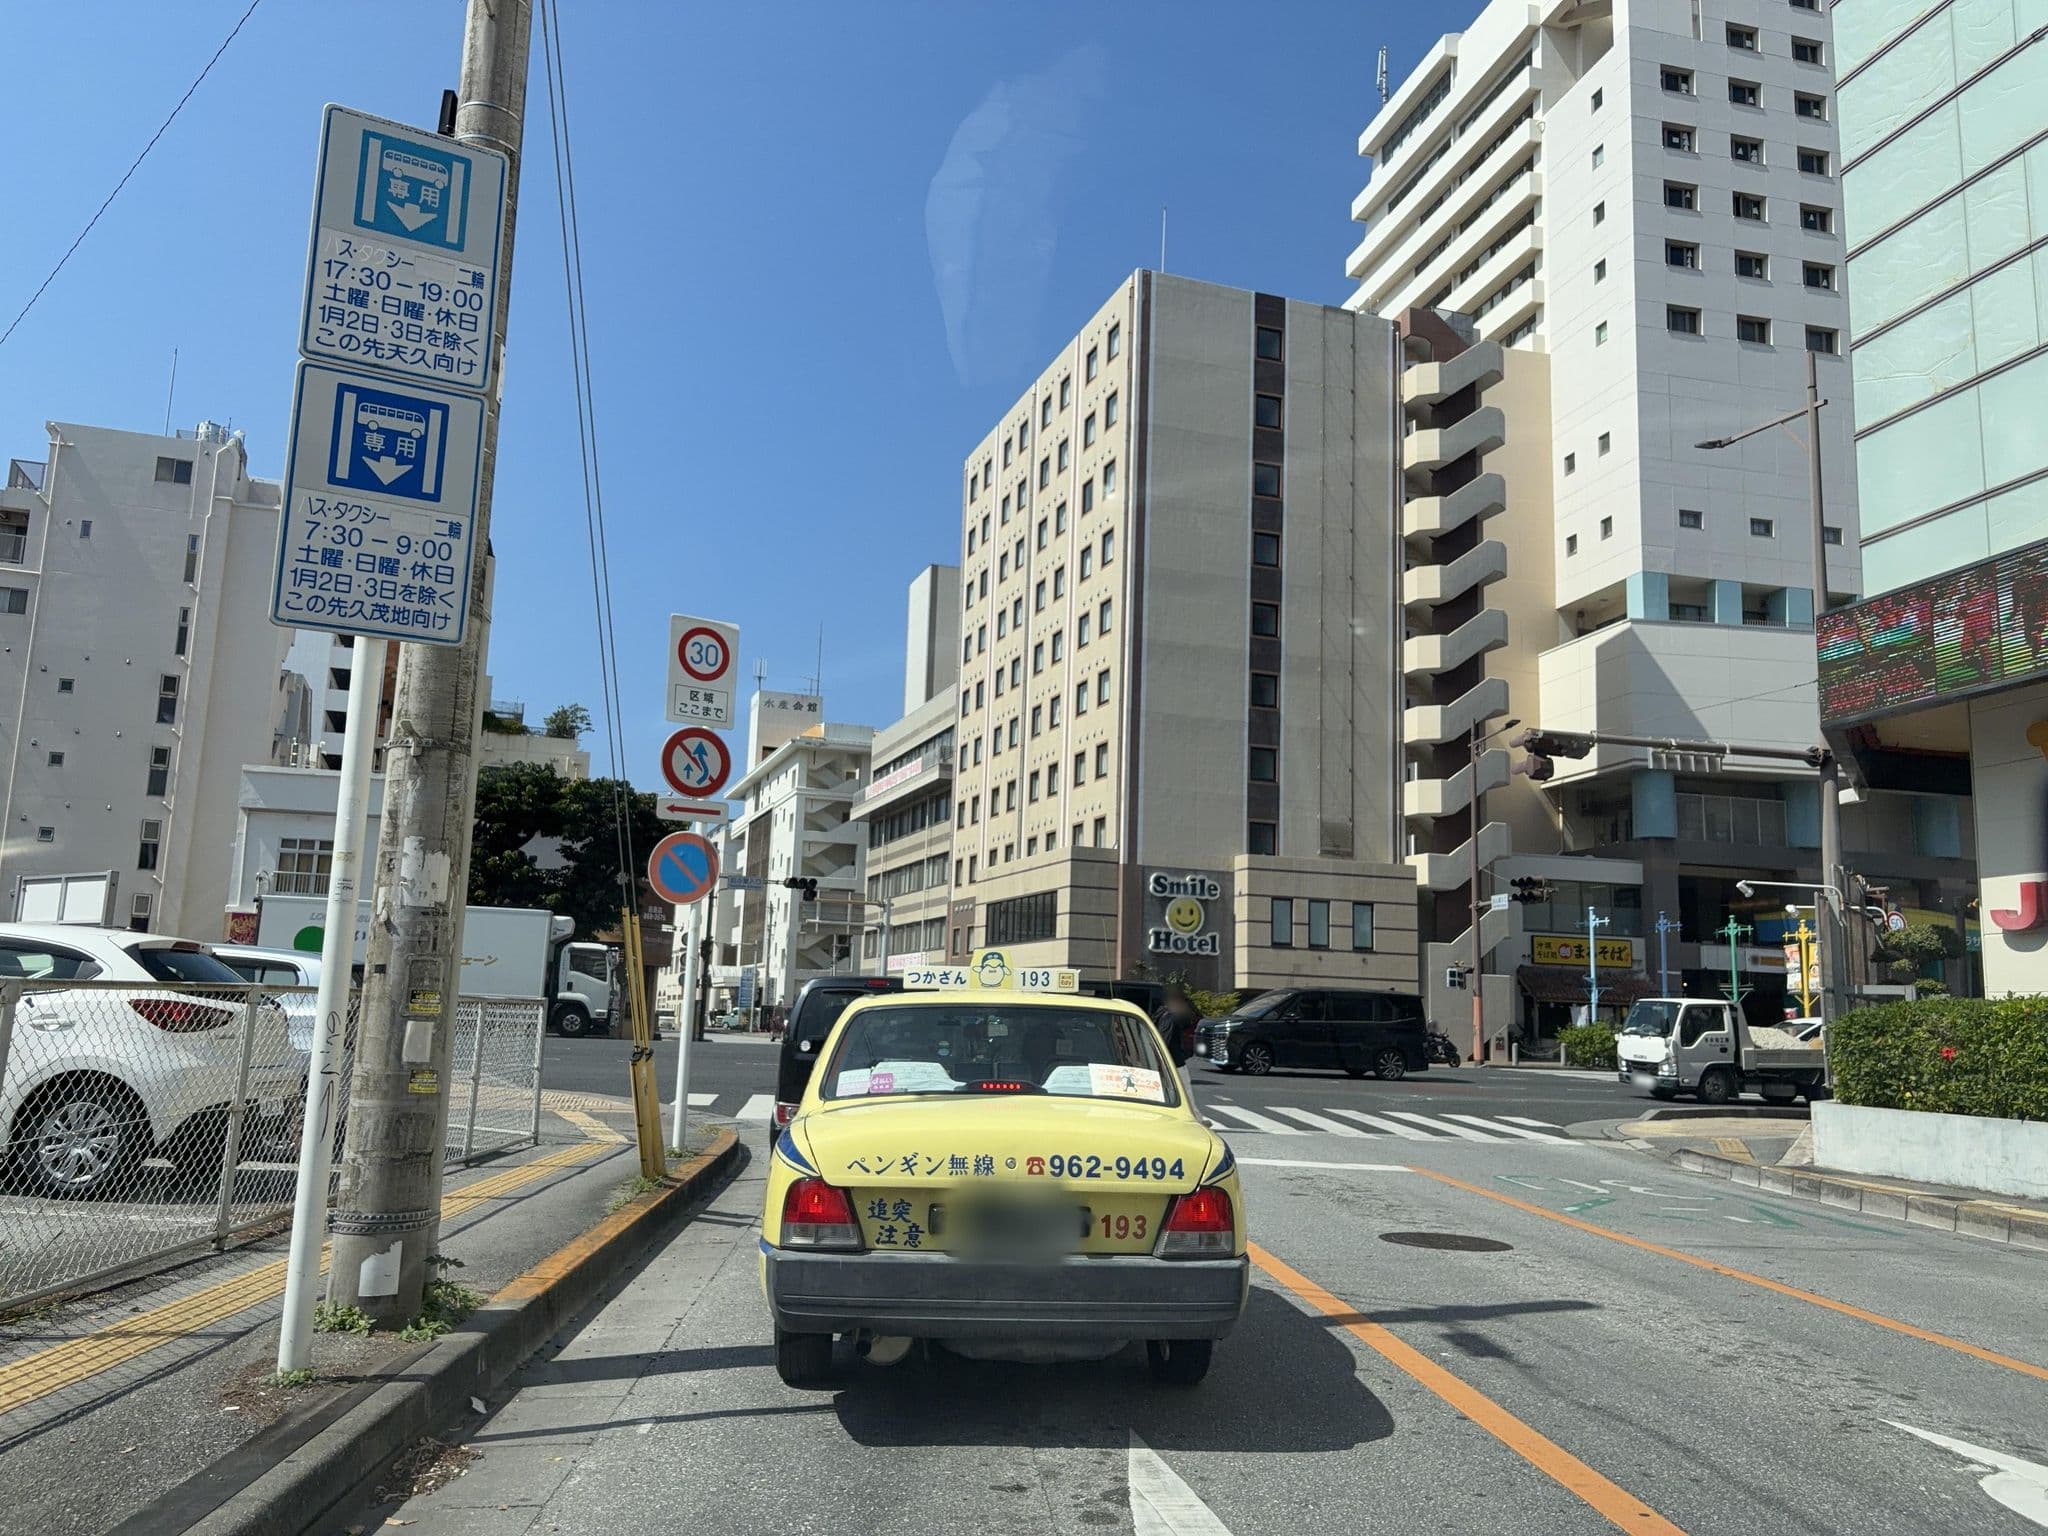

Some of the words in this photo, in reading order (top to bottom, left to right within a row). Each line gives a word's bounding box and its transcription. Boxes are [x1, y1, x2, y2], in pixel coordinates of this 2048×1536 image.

[388, 178, 441, 208] 専用
[458, 268, 485, 290] 二輪
[315, 327, 477, 376] この先天久向け
[363, 432, 417, 459] 専用
[433, 519, 463, 540] 二輪
[284, 591, 452, 631] この先久茂地向け
[689, 641, 719, 668] 30
[689, 690, 714, 705] 区域
[679, 702, 724, 719] ここまで
[1152, 874, 1219, 898] Smile
[1151, 930, 1218, 954] Hotel
[907, 970, 967, 985] つかざん
[1020, 971, 1050, 987] 193
[846, 1152, 996, 1176] ペンギン無線
[1049, 1154, 1185, 1180] 962-9494
[867, 1198, 913, 1223] 追突
[875, 1222, 925, 1249] 注意
[1100, 1214, 1148, 1240] 193
